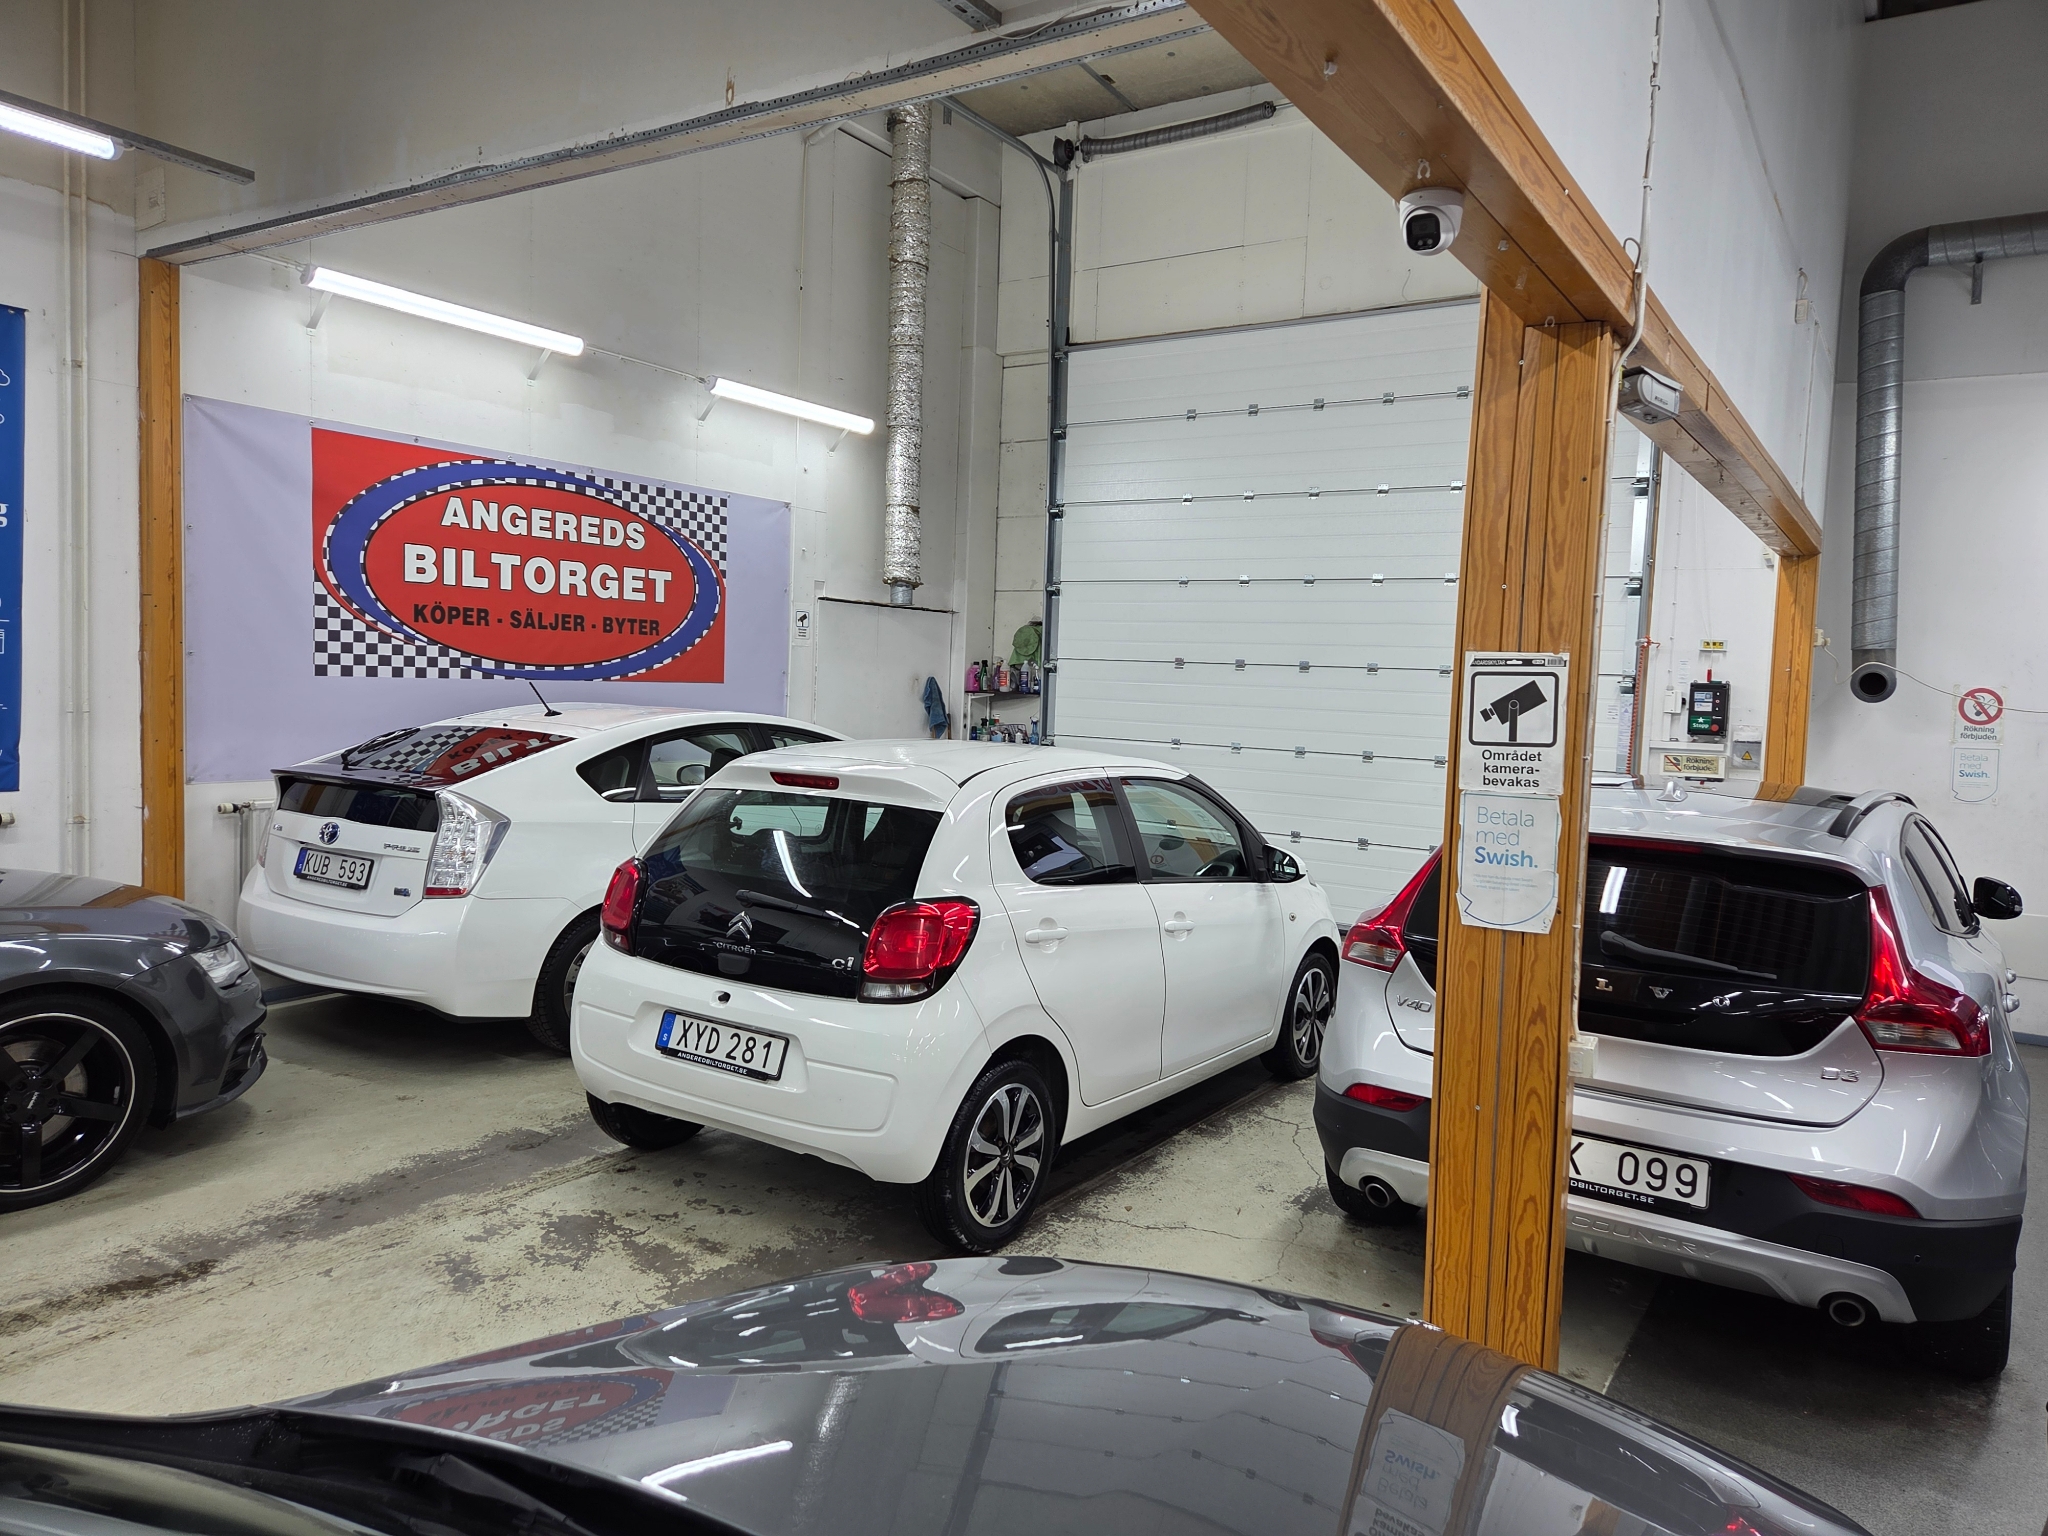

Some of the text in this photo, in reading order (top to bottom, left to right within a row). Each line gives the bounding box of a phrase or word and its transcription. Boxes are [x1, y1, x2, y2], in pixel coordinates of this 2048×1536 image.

[440, 496, 646, 550] ANGEREDS
[403, 543, 672, 603] BILTORGET
[413, 601, 660, 636] KÖPER SÄLJER BYTER
[1960, 732, 1997, 741] förbjuden
[1963, 725, 1995, 734] Rökning
[1482, 749, 1542, 762] Området
[1960, 753, 1988, 762] Betala
[1484, 762, 1540, 775] kamera-
[1958, 769, 1990, 778] Swish.
[1483, 775, 1540, 788] bevakas
[1477, 806, 1534, 828] Betala
[1476, 829, 1520, 846] med
[303, 853, 366, 882] KUB 593
[1474, 846, 1538, 868] Swish.
[1595, 977, 1731, 1007] LVO
[1396, 994, 1432, 1013] V40
[662, 1033, 668, 1041] S
[676, 1019, 773, 1069] XYD 281
[677, 1052, 748, 1075] ANGEREDBILTORGET.SE
[1570, 1141, 1698, 1199] K 099
[1570, 1179, 1655, 1204] DBILTORGET.SE
[1571, 1216, 1721, 1258] COUNTRY
